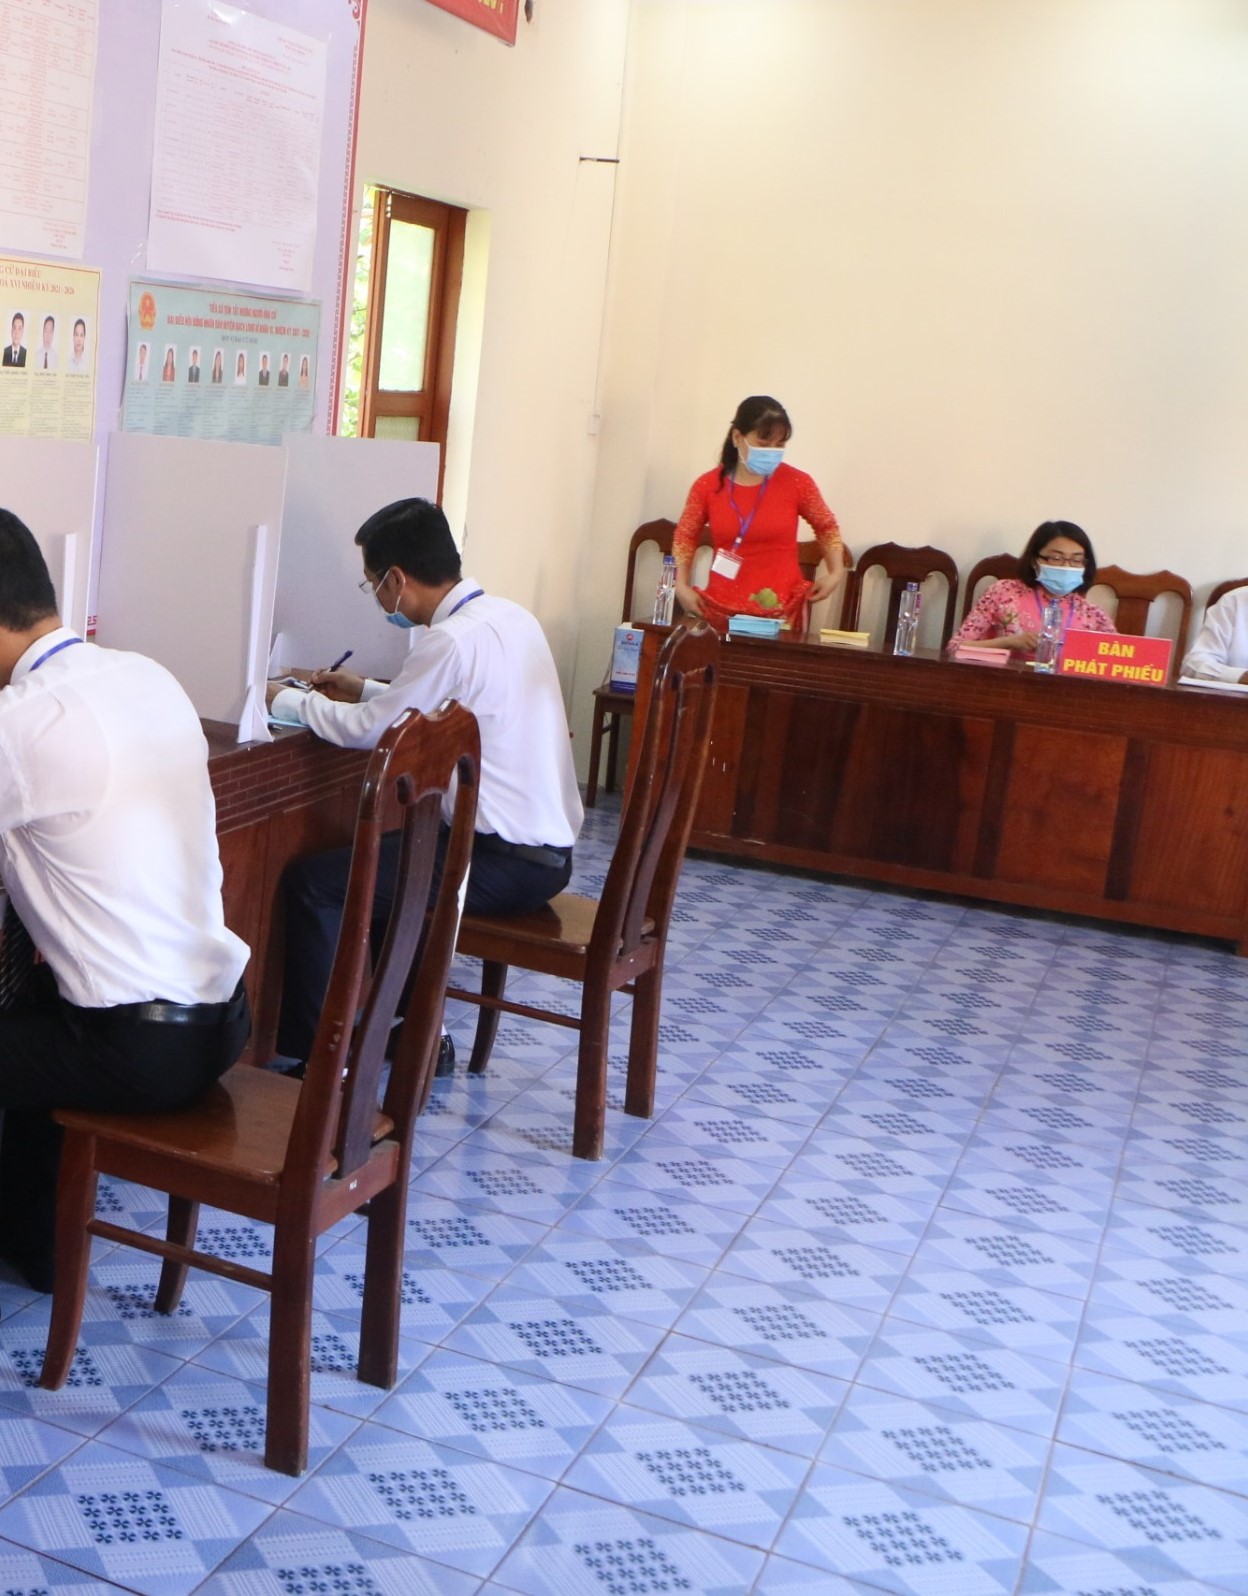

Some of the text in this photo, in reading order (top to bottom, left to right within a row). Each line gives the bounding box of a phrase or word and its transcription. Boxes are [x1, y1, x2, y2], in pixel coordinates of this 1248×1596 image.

[1098, 641, 1135, 658] BÀN
[1063, 659, 1164, 682] PHÁT PHIẾU
